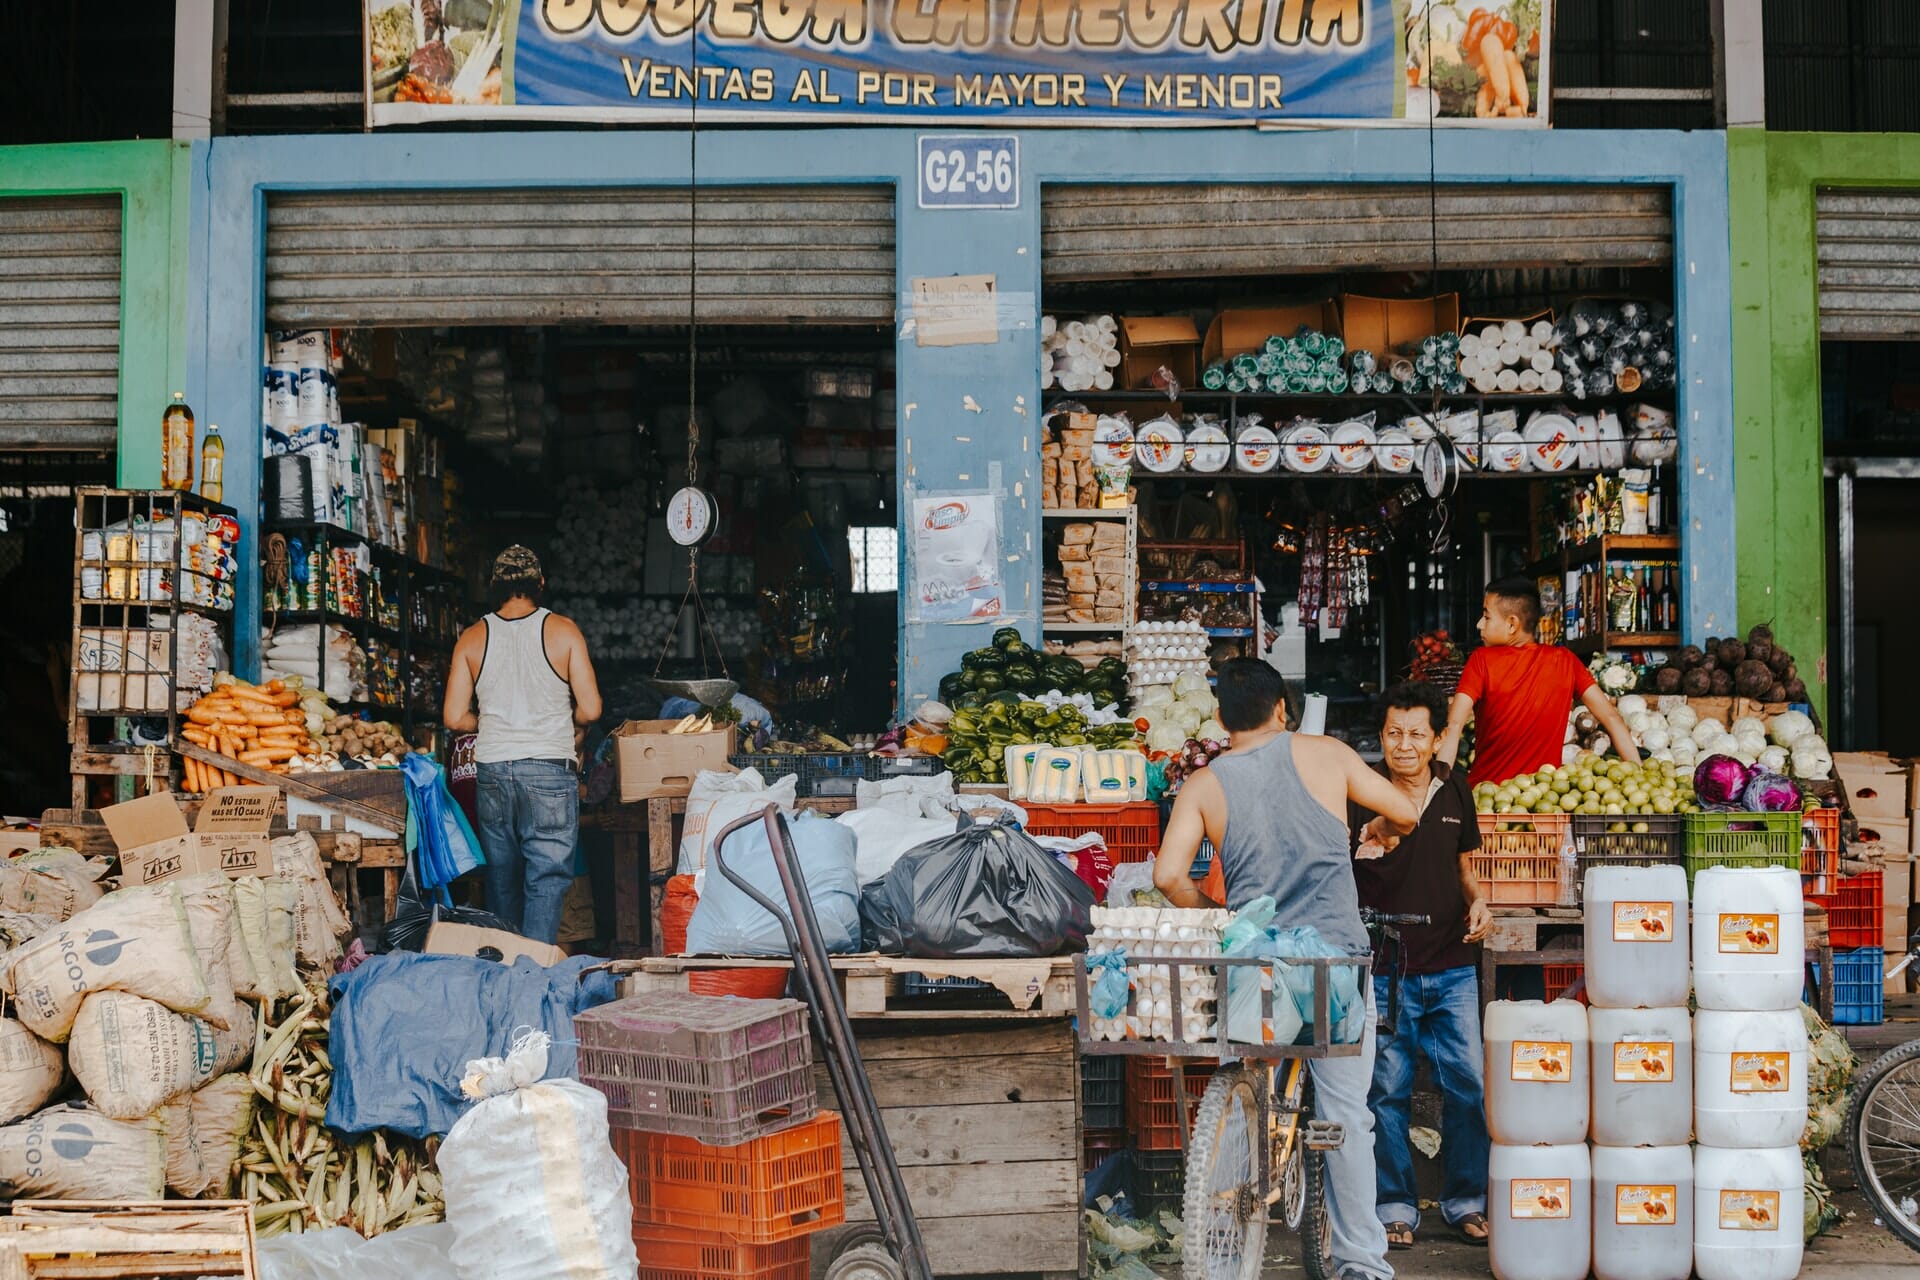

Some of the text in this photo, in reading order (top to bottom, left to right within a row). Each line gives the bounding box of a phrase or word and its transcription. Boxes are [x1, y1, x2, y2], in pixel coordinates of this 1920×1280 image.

[621, 56, 1283, 110] VENTAS AL POR MAYOR Y MENOR
[925, 149, 1014, 194] G2-56
[221, 795, 234, 806] NO
[234, 806, 245, 816] 10
[59, 930, 88, 993] ARGOS
[35, 989, 55, 1019] 42.5
[145, 1006, 156, 1028] PESO
[148, 1030, 160, 1052] NETO
[26, 1117, 45, 1178] RGOS
